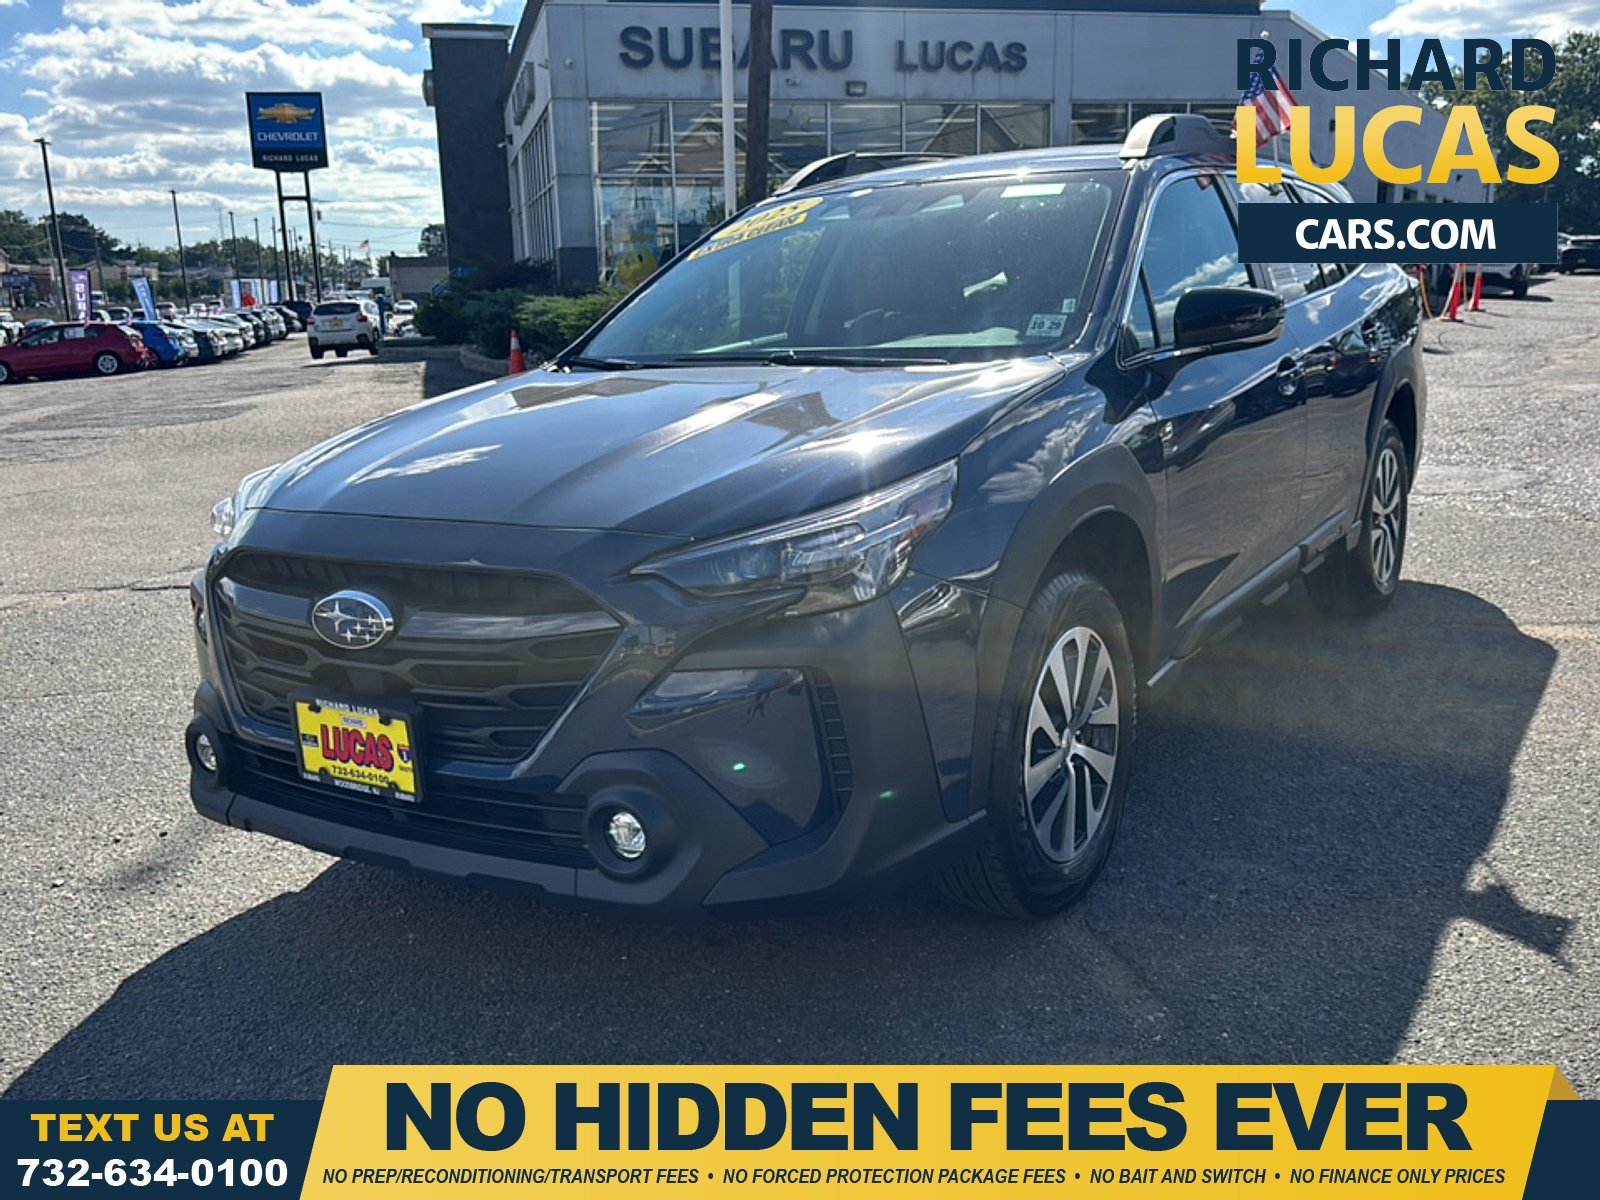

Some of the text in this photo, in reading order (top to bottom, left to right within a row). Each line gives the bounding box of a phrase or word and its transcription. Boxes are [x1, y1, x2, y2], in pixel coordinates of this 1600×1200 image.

[896, 40, 1028, 73] LUCAS
[257, 132, 318, 141] CHEVROLET
[295, 154, 319, 162] LUCAS
[315, 698, 380, 718] RICHARD LUCAS
[320, 724, 394, 772] LUCAS
[331, 765, 390, 784] 732-634-0100
